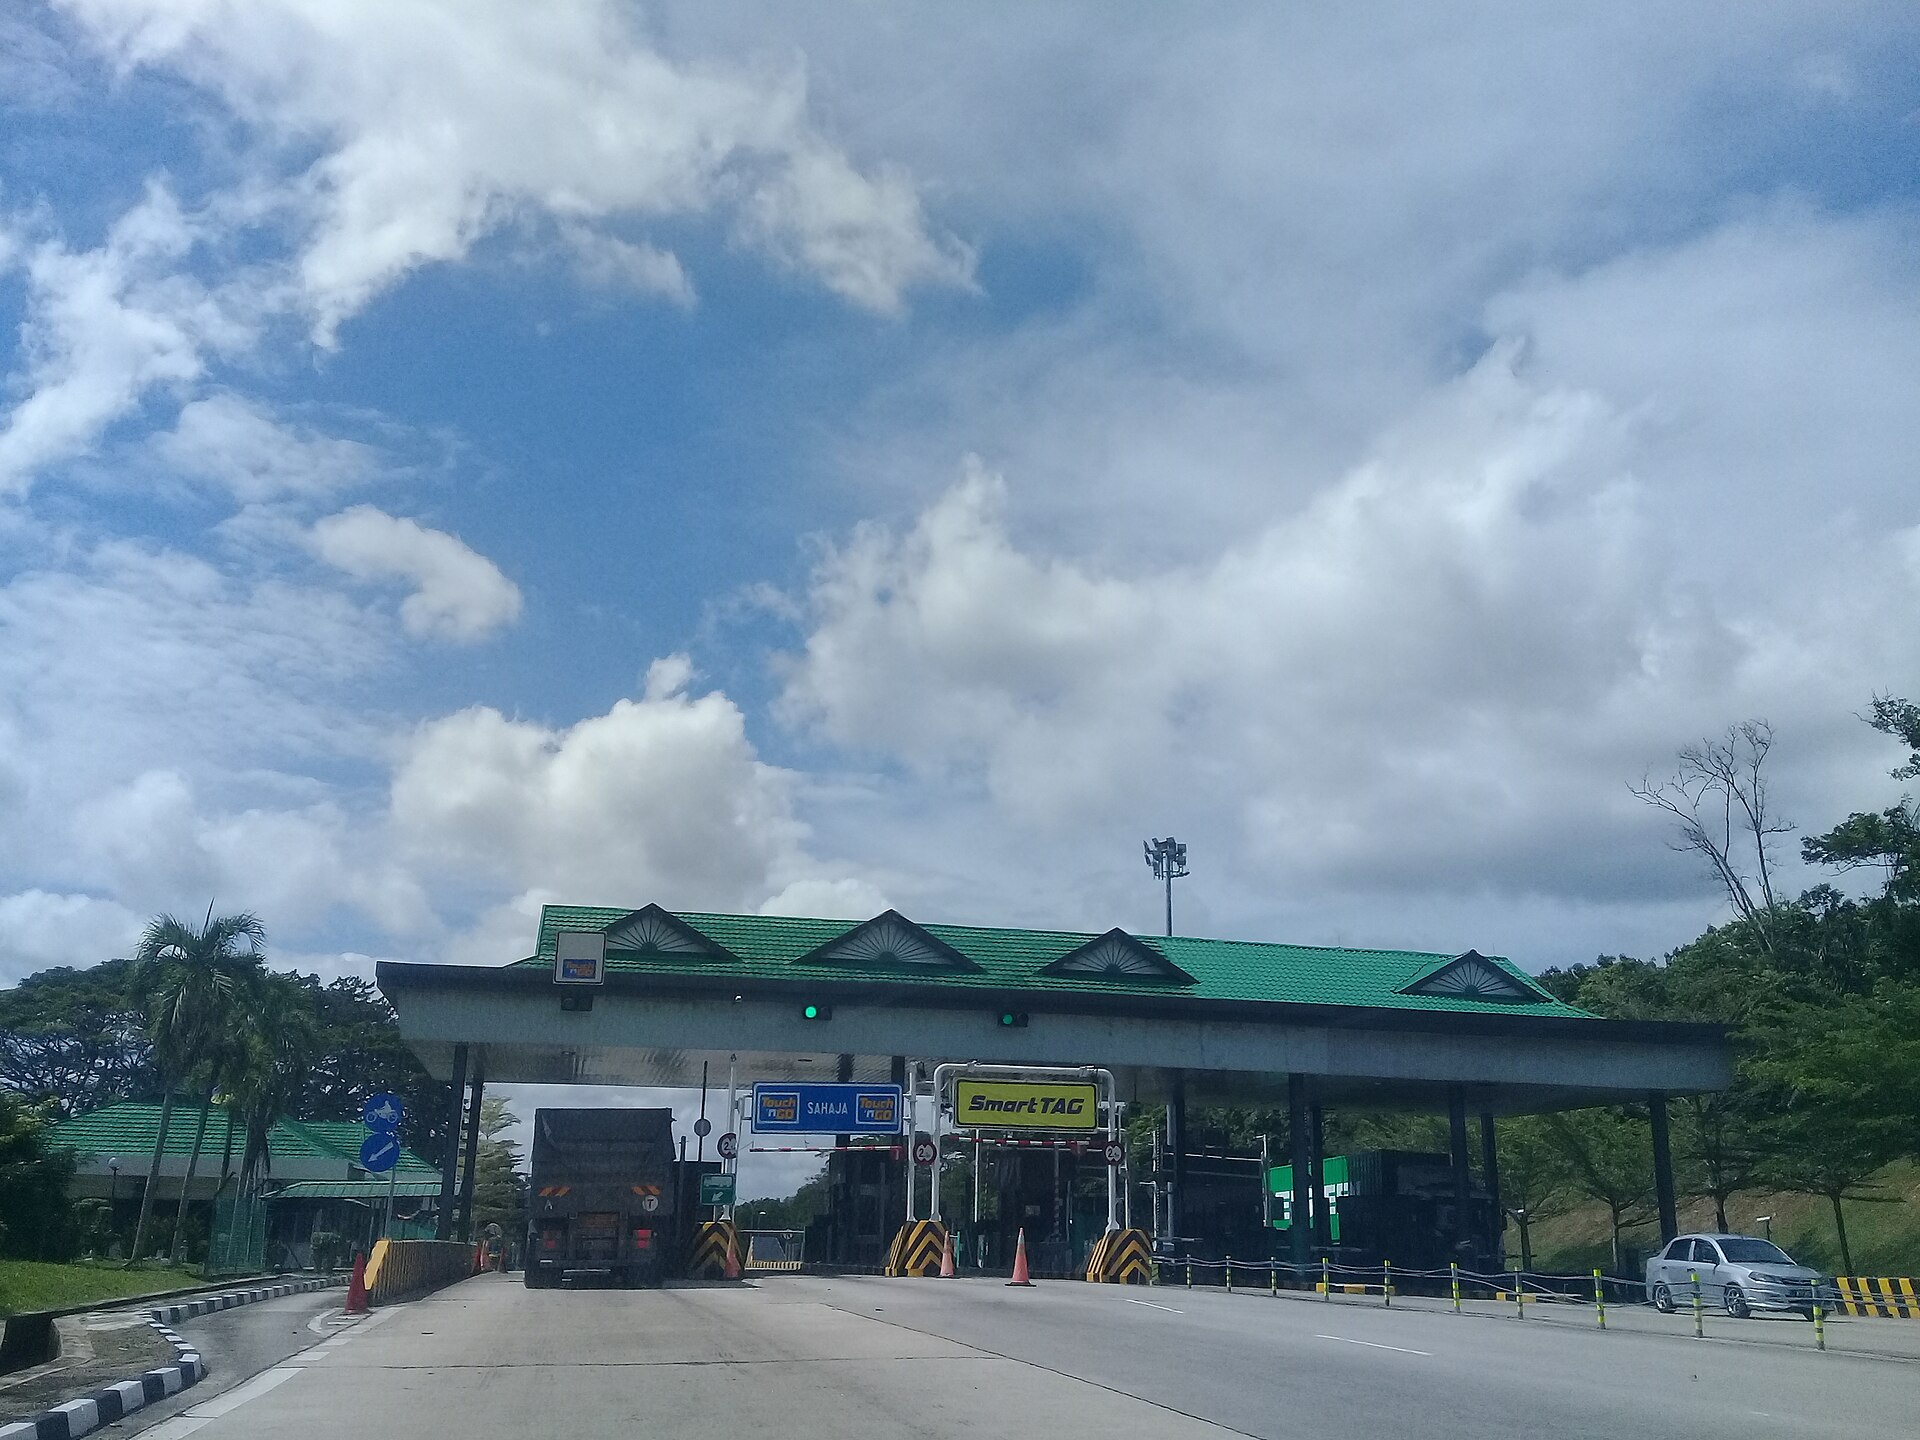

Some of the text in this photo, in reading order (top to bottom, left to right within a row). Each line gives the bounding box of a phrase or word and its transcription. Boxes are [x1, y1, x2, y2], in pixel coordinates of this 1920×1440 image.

[762, 1096, 796, 1108] Touch
[807, 1101, 848, 1115] SAHAJA
[859, 1097, 894, 1109] Touch
[647, 1198, 654, 1209] T
